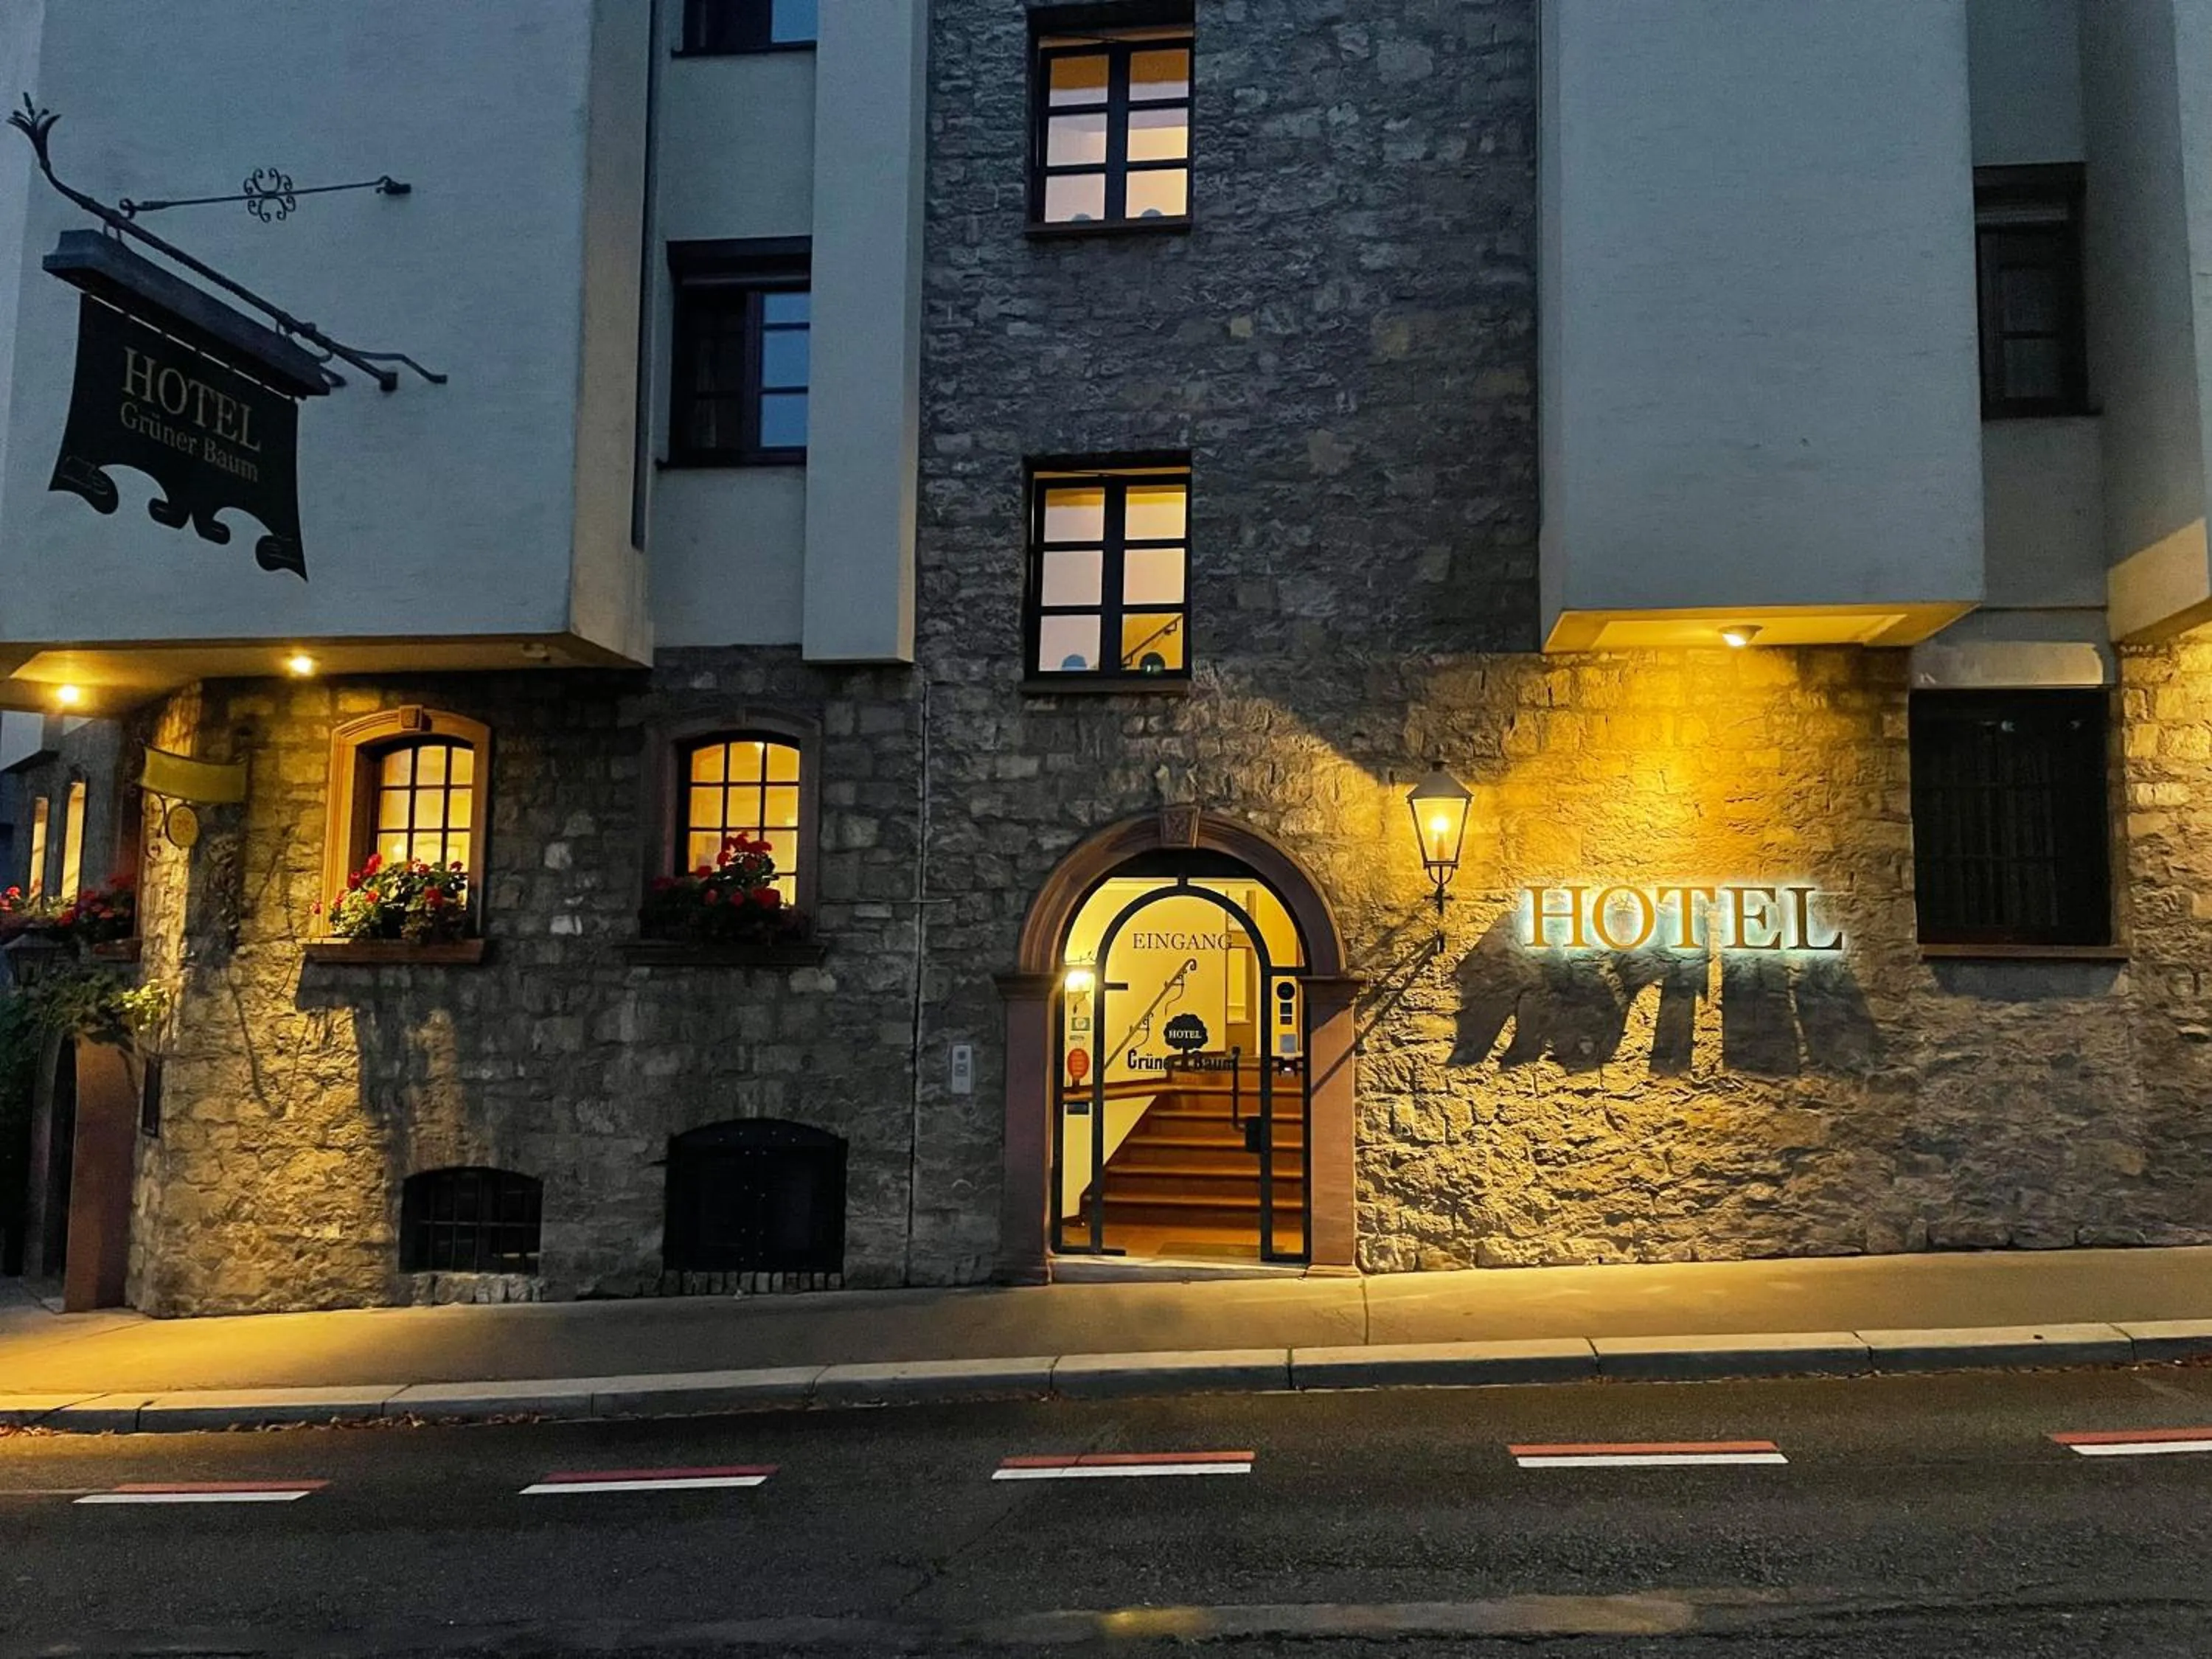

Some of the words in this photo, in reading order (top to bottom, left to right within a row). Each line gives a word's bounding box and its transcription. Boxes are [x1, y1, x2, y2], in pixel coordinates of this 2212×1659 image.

[122, 346, 260, 452] HOTEL
[120, 401, 198, 455] Grüner
[203, 437, 258, 482] Baum
[1133, 933, 1233, 950] EINGANG
[1524, 885, 1843, 950] HOTEL
[1169, 1030, 1202, 1039] HOTEL
